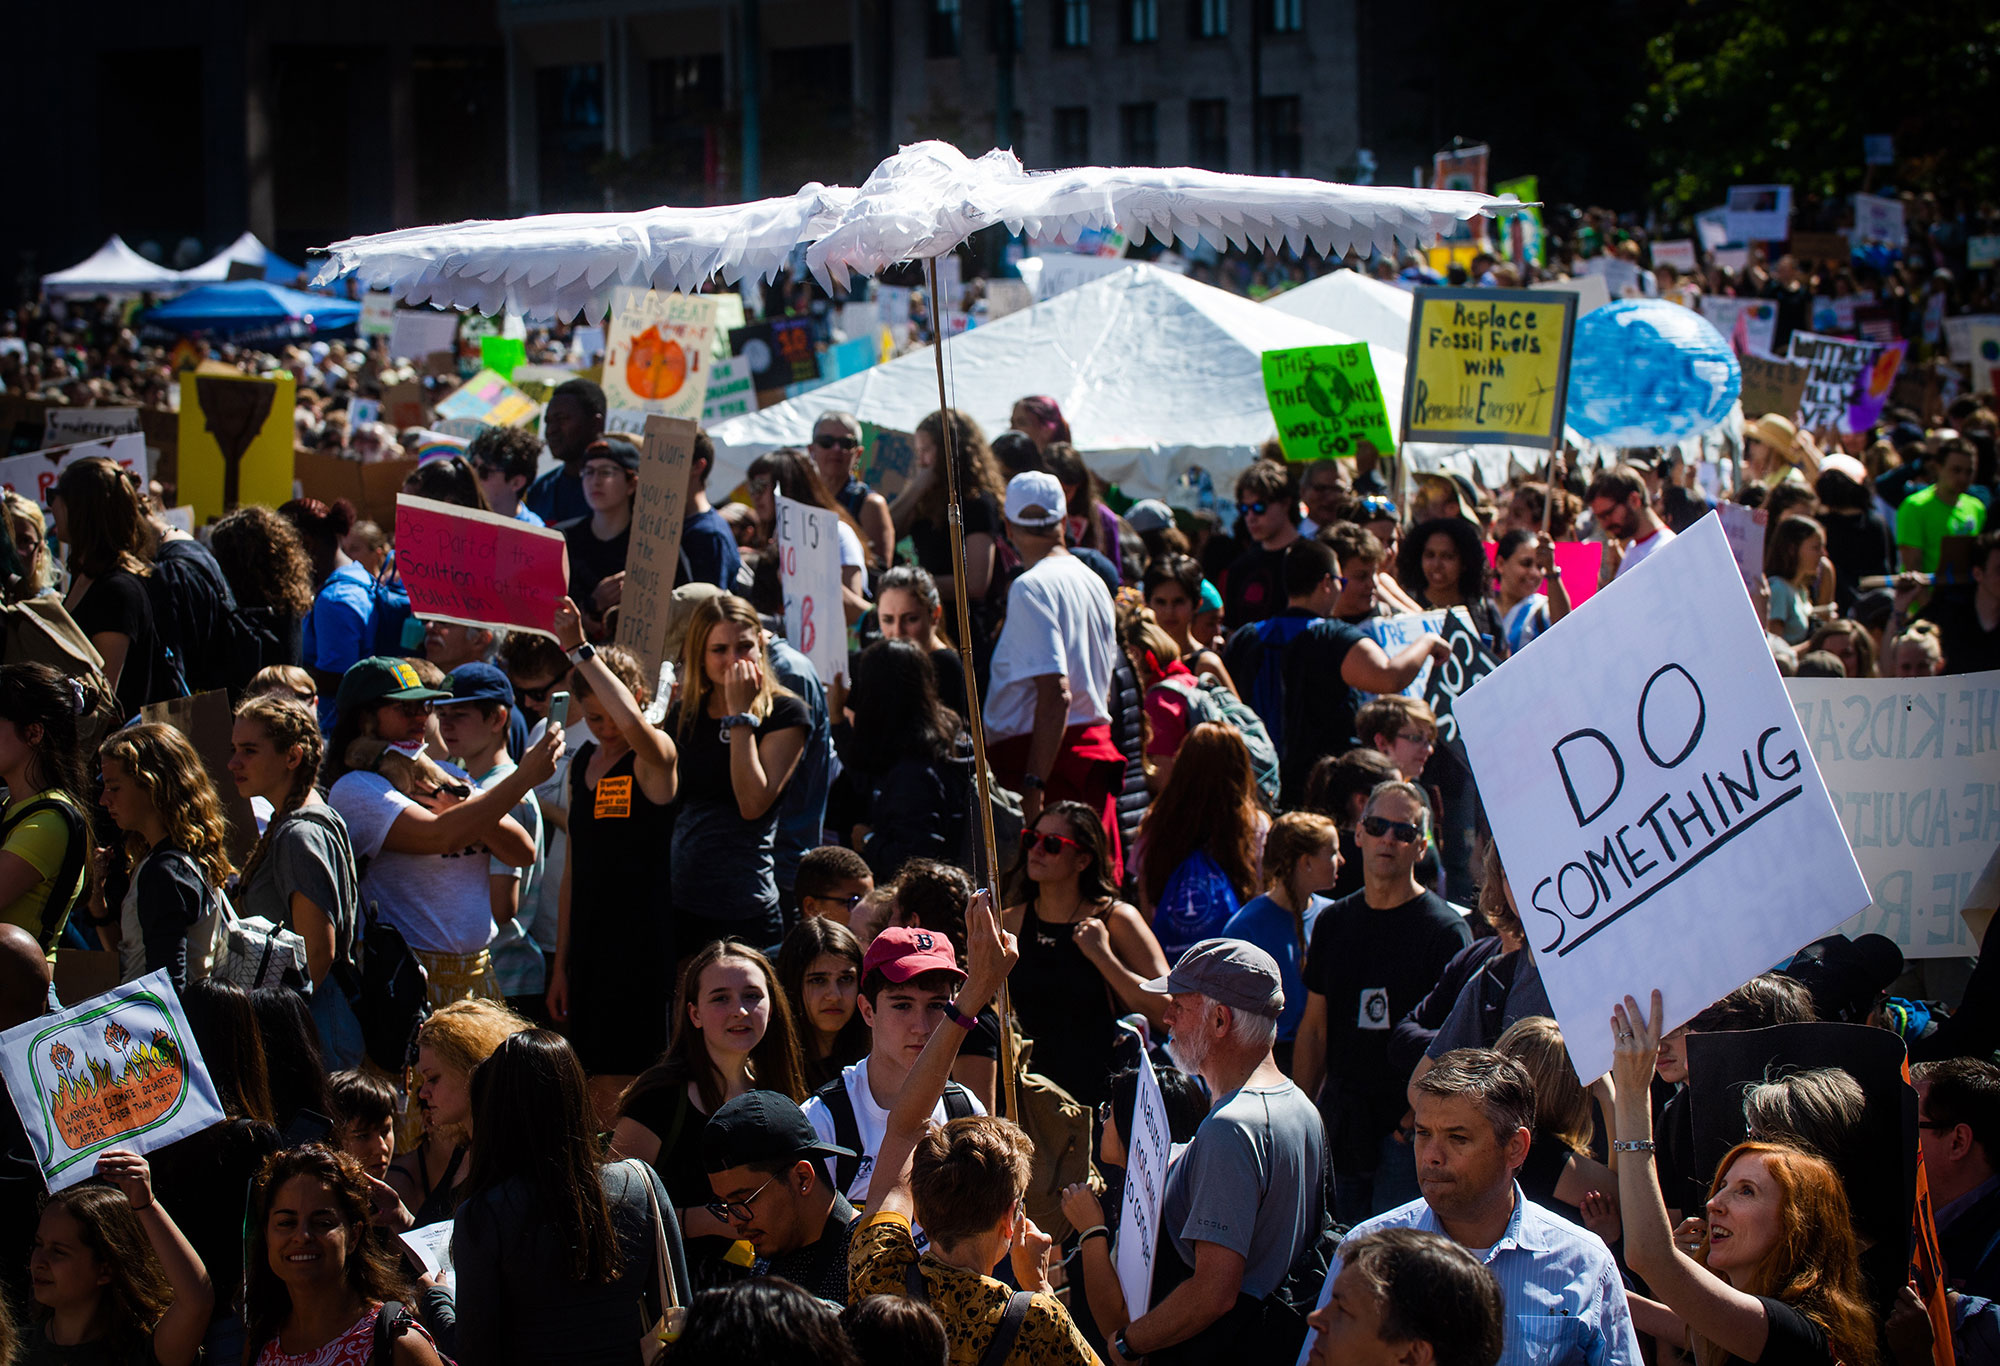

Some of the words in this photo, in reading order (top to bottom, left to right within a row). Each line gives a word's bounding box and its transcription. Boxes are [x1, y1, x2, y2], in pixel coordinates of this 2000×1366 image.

[1453, 302, 1537, 330] Replace
[1429, 327, 1483, 352] Fossil
[1491, 331, 1542, 354] Fuels
[1271, 352, 1314, 378] THIS
[1337, 348, 1359, 368] IS
[1464, 358, 1505, 377] with
[1271, 385, 1306, 407] THE
[1413, 379, 1474, 425] Renewable
[1476, 381, 1527, 426] Energy
[1284, 419, 1342, 438] WORLD
[647, 433, 656, 462] I
[638, 483, 663, 515] you
[398, 509, 425, 544] Be
[477, 537, 497, 559] of
[511, 547, 536, 568] the
[802, 511, 820, 550] IS
[484, 575, 511, 596] not
[516, 582, 541, 600] the
[630, 561, 661, 596] HOUSE
[622, 615, 653, 654] FIRE
[801, 595, 816, 654] B
[1551, 662, 1706, 828] DO
[1531, 726, 1802, 954] SOMETHING
[103, 1088, 136, 1109] CLIMATE
[141, 1073, 179, 1096] DISASTERS
[66, 1122, 84, 1137] MAY
[86, 1119, 98, 1131] BE
[99, 1106, 131, 1128] CLOSER
[132, 1099, 152, 1112] THAN
[154, 1091, 173, 1104] THEY
[79, 1128, 107, 1145] APPEAR
[1126, 1169, 1134, 1203] to
